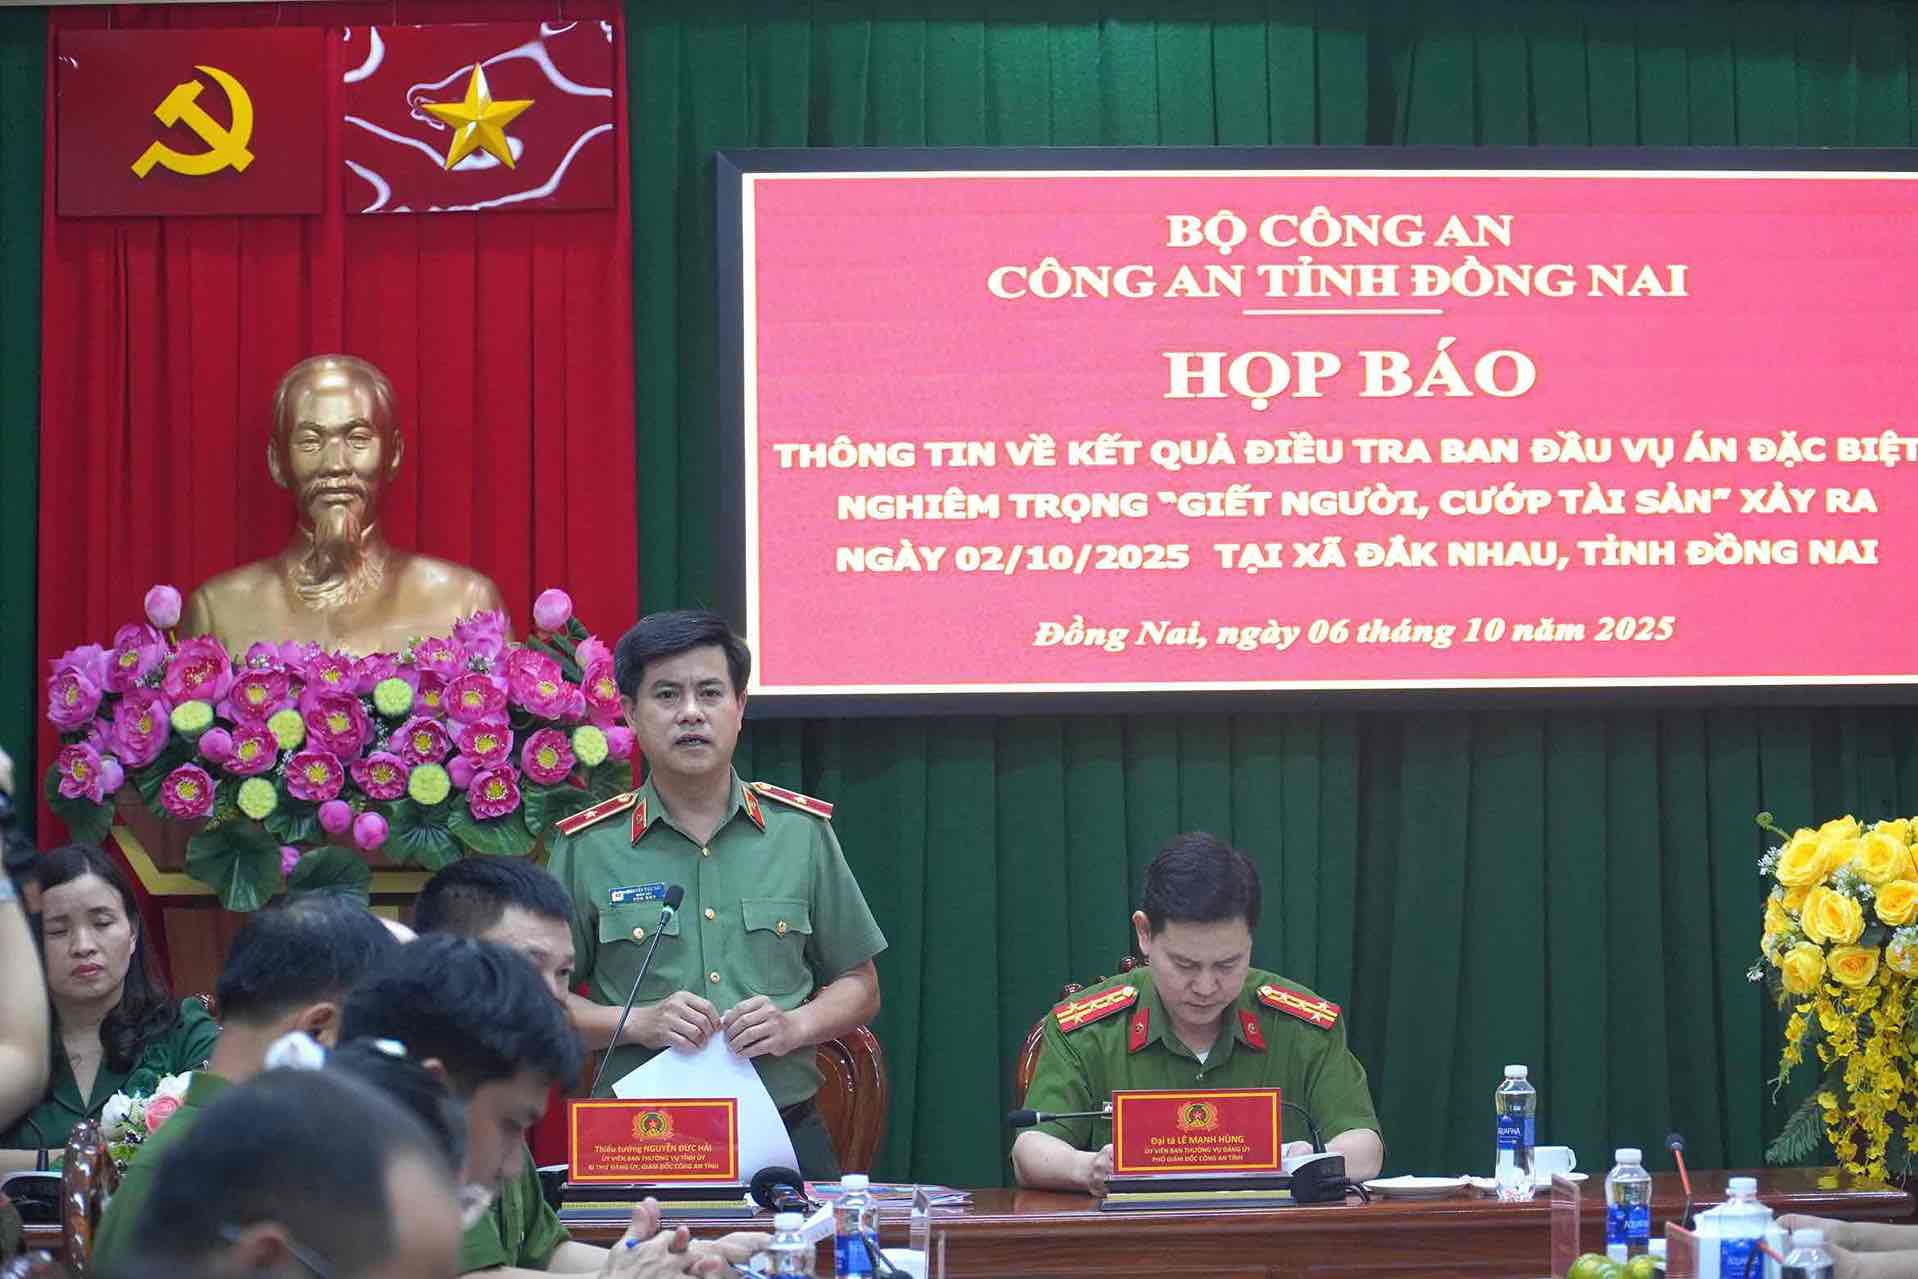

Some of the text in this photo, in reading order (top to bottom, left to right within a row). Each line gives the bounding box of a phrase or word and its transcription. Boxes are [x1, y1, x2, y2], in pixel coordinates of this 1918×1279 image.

[1167, 206, 1513, 254] BỘ CÔNG AN
[988, 256, 1688, 298] CÔNG AN TỈNH ĐỒNG NAI
[1163, 337, 1535, 410] HỌP BÁO
[773, 430, 1918, 470] THÔNG TIN VỀ KẾT QUẢ ĐIỀU TRA BAN ĐẦU VỤ ÁN ĐẶC BIỆT
[838, 487, 1000, 519] NGHIÊM
[1008, 493, 1148, 523] TRỌNG
[1282, 483, 1429, 519] NGƯỜI,
[1440, 482, 1551, 515] CƯỚP
[1558, 482, 1625, 514] TÀI
[1740, 481, 1815, 513] XẢY
[1826, 489, 1877, 512] RA
[837, 539, 946, 572] NGÀY
[956, 544, 1189, 575] 02/10/2025
[1214, 544, 1282, 573] TẠI
[1293, 536, 1346, 568] XÃ
[1448, 541, 1569, 570] NHAU,
[1577, 534, 1675, 565] TỈNH
[1685, 533, 1797, 565] ĐỒNG
[1809, 540, 1878, 564] NAI
[1032, 615, 1675, 652] Đồng Nai, ngày 06 tháng 10 năm 2025
[1177, 1134, 1188, 1145] LÊ
[1219, 1134, 1245, 1144] HÙNG
